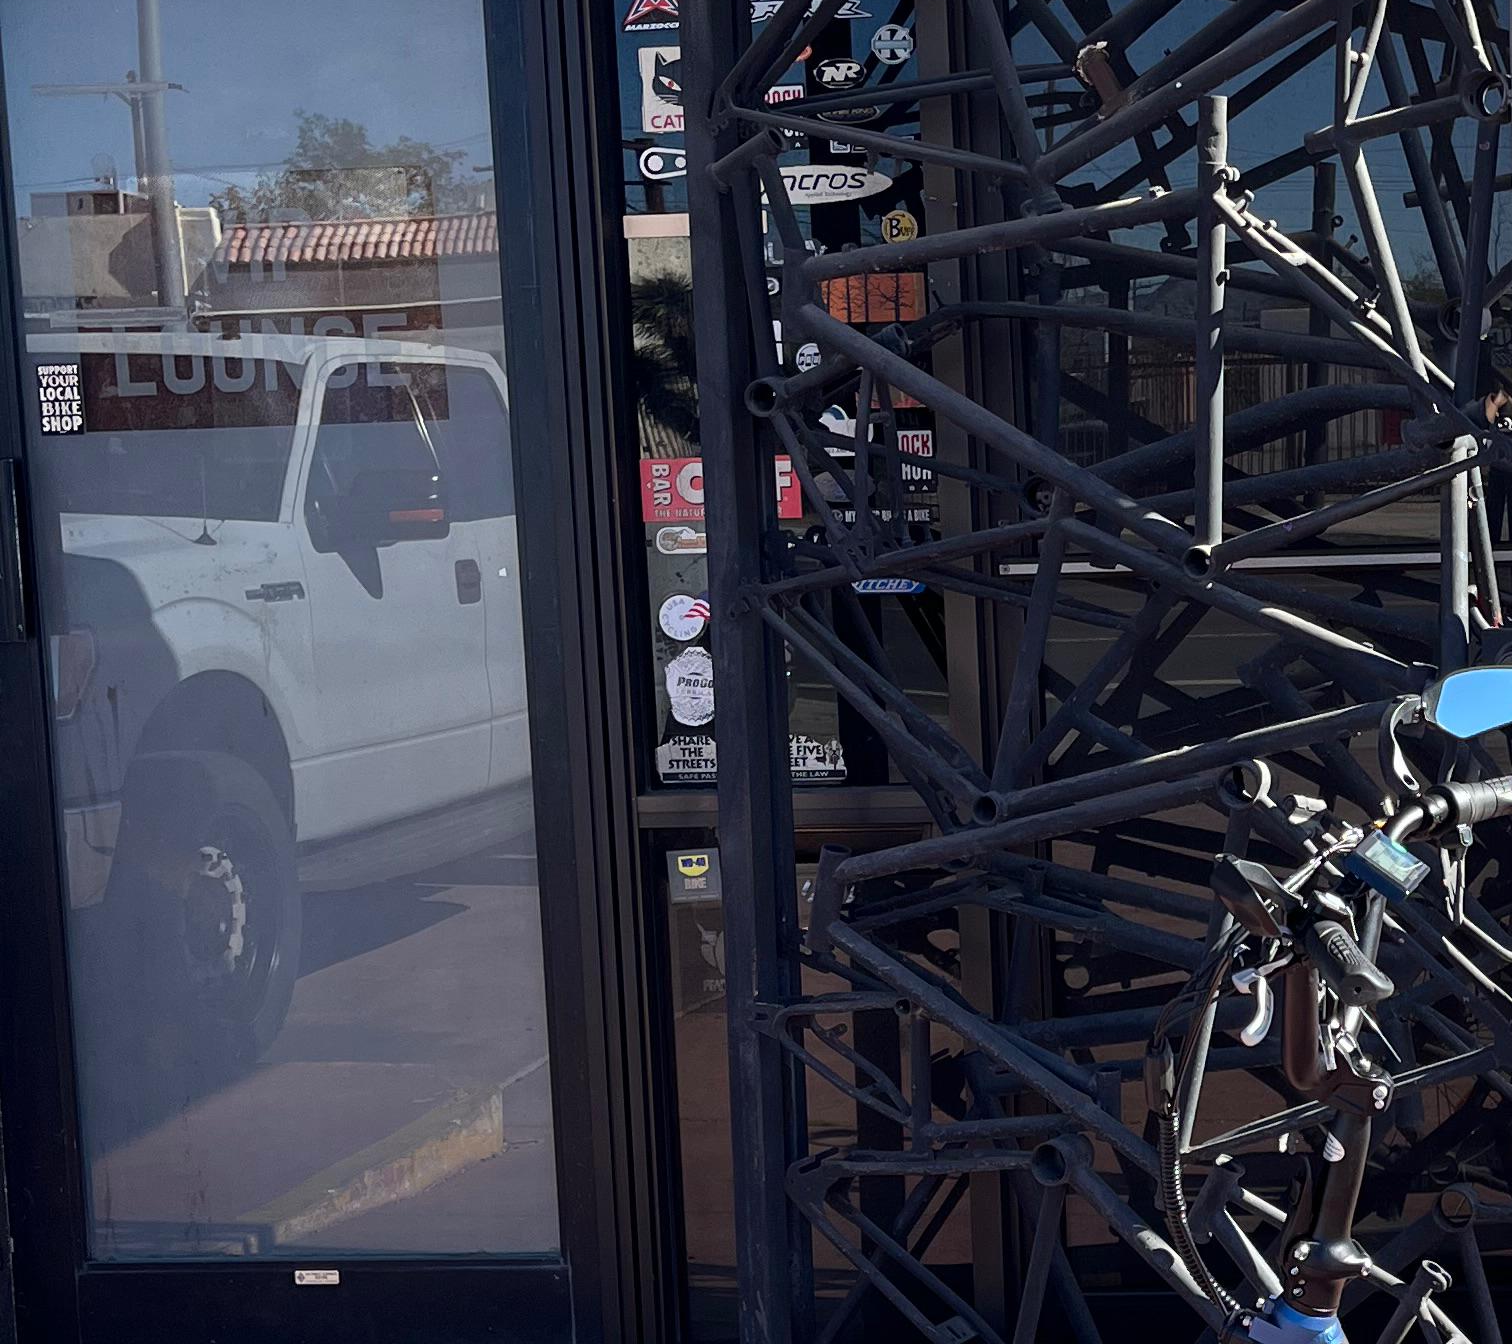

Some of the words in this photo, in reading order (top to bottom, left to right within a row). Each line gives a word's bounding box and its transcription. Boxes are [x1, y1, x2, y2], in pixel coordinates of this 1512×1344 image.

[651, 115, 684, 130] CAT
[783, 173, 867, 191] ncros
[111, 312, 412, 398] LOUNGE
[38, 364, 78, 375] SUPPORT
[40, 374, 79, 387] YOUR
[39, 386, 81, 401] LOCAL
[42, 401, 82, 416] BIKE
[42, 415, 83, 432] SHOP
[651, 464, 672, 506] BAR
[654, 509, 671, 517] THE
[665, 598, 686, 612] USA
[661, 613, 698, 639] CYCLING
[672, 735, 711, 746] SHARE
[680, 747, 704, 757] THE
[797, 745, 824, 756] FIVE
[668, 759, 717, 769] STREETS
